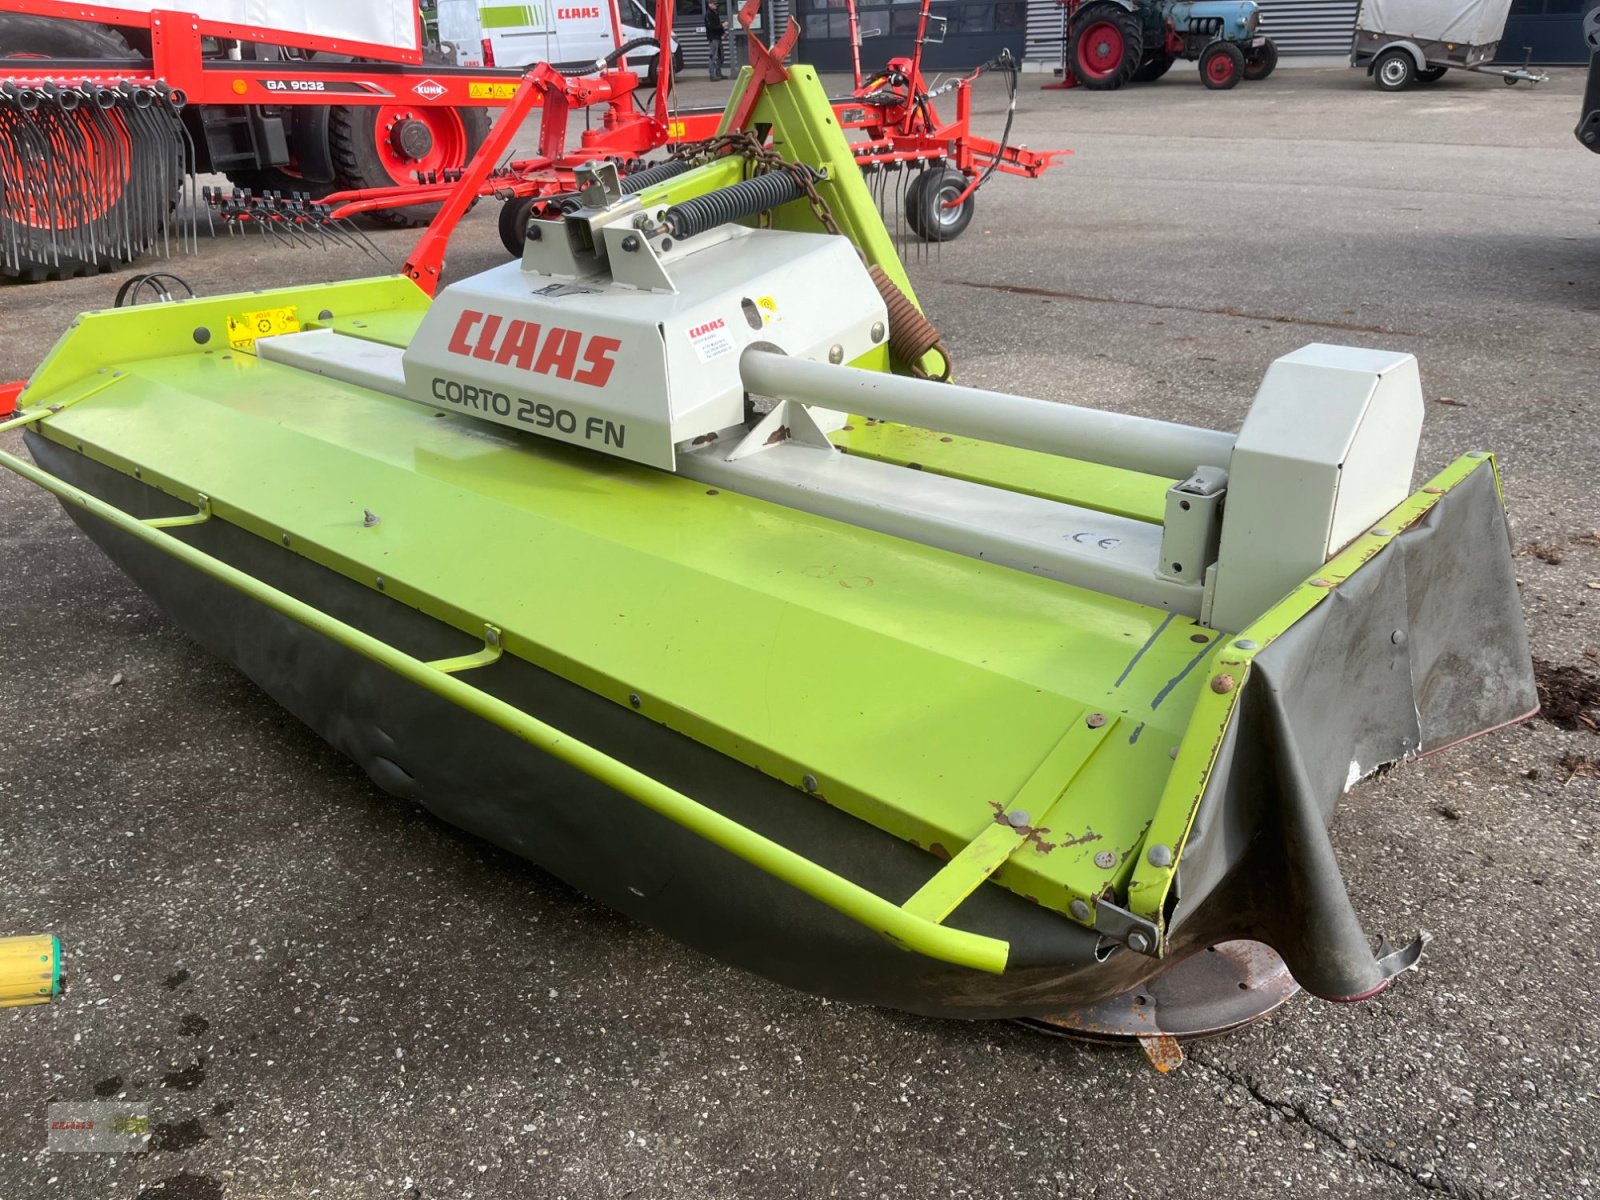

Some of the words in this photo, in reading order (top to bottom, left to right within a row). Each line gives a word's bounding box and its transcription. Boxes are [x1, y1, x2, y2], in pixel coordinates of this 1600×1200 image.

[557, 7, 599, 20] CLAAS
[266, 80, 287, 90] GA
[291, 80, 325, 91] 9032
[417, 85, 442, 95] KUHN
[689, 318, 725, 338] CLAAS
[448, 309, 622, 388] CLAAS
[432, 377, 510, 416] CORTO
[517, 398, 577, 434] 290
[585, 417, 626, 449] FN
